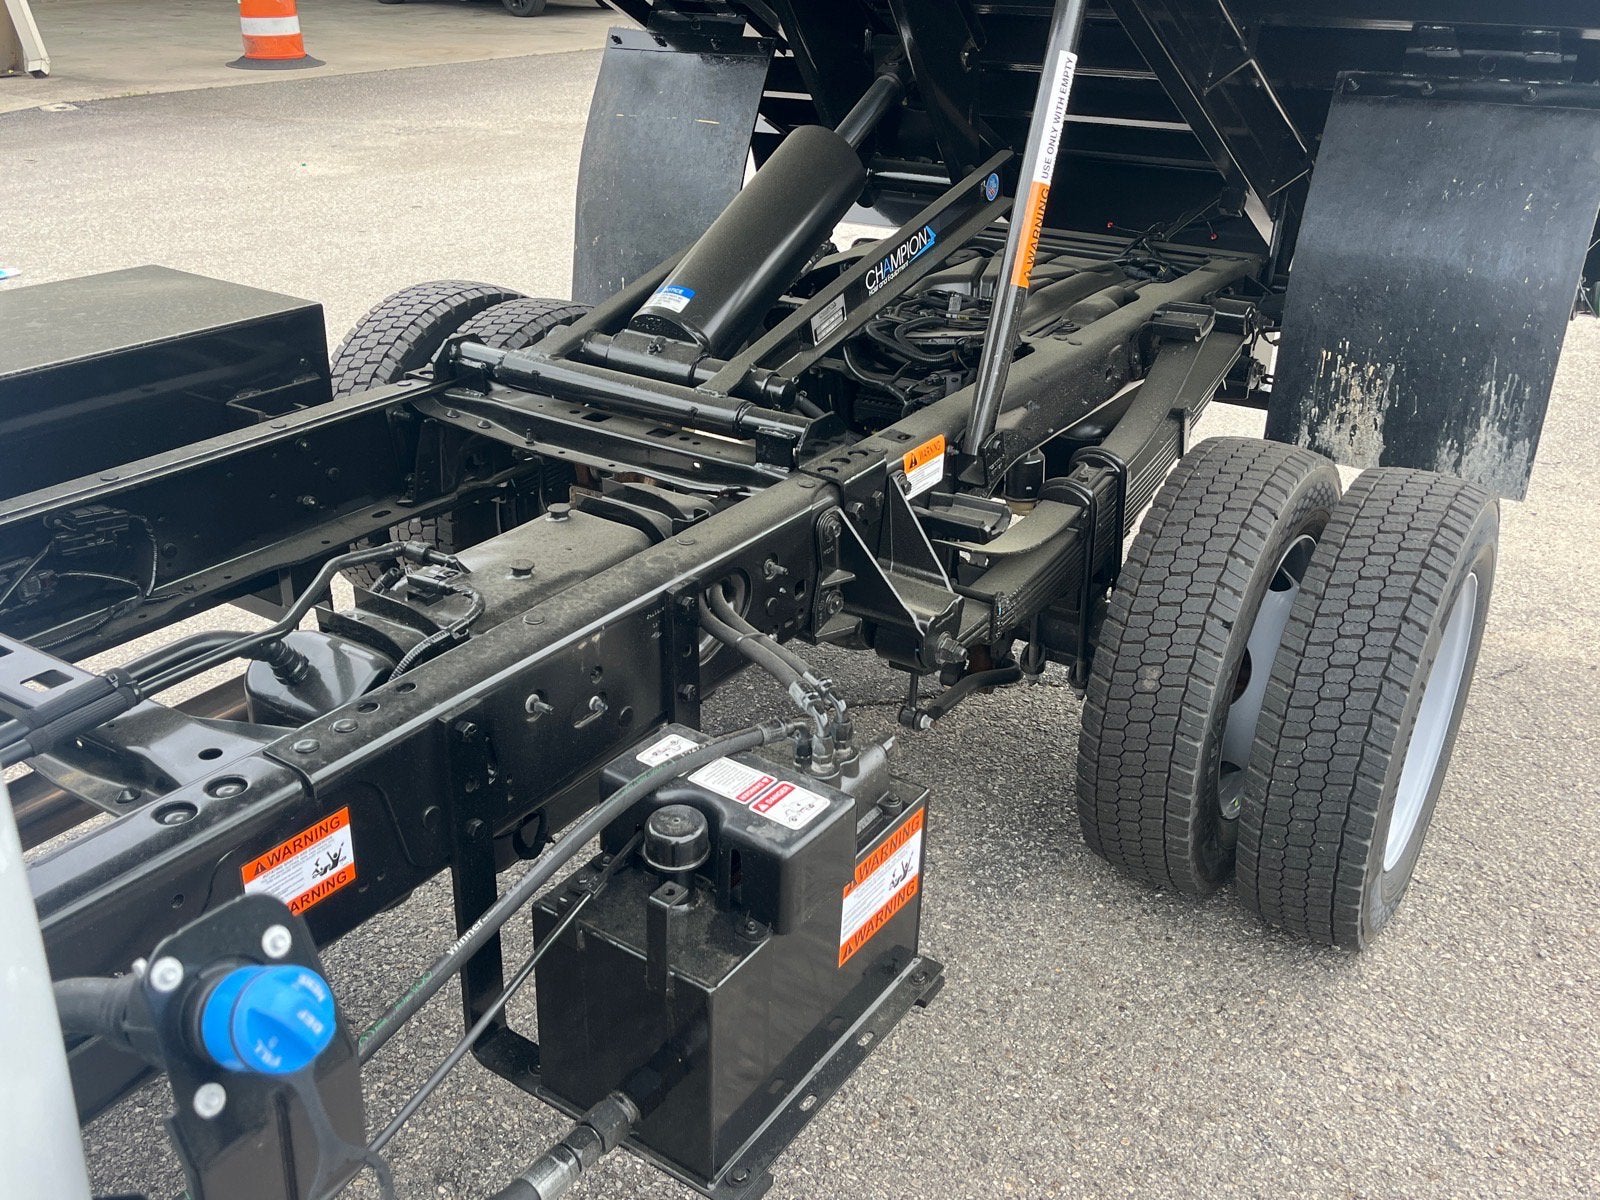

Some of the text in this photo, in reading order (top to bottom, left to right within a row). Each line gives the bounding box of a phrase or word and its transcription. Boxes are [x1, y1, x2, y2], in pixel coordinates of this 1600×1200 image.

[1041, 56, 1074, 179] USE ONLY WITH EMPTY
[1027, 187, 1050, 266] WARNING
[865, 228, 928, 290] CHAMPION
[267, 816, 340, 867] WARNING
[859, 814, 920, 880] WARNING
[290, 870, 347, 913] ARNING
[855, 880, 915, 943] WARNING
[446, 918, 483, 956] Winner
